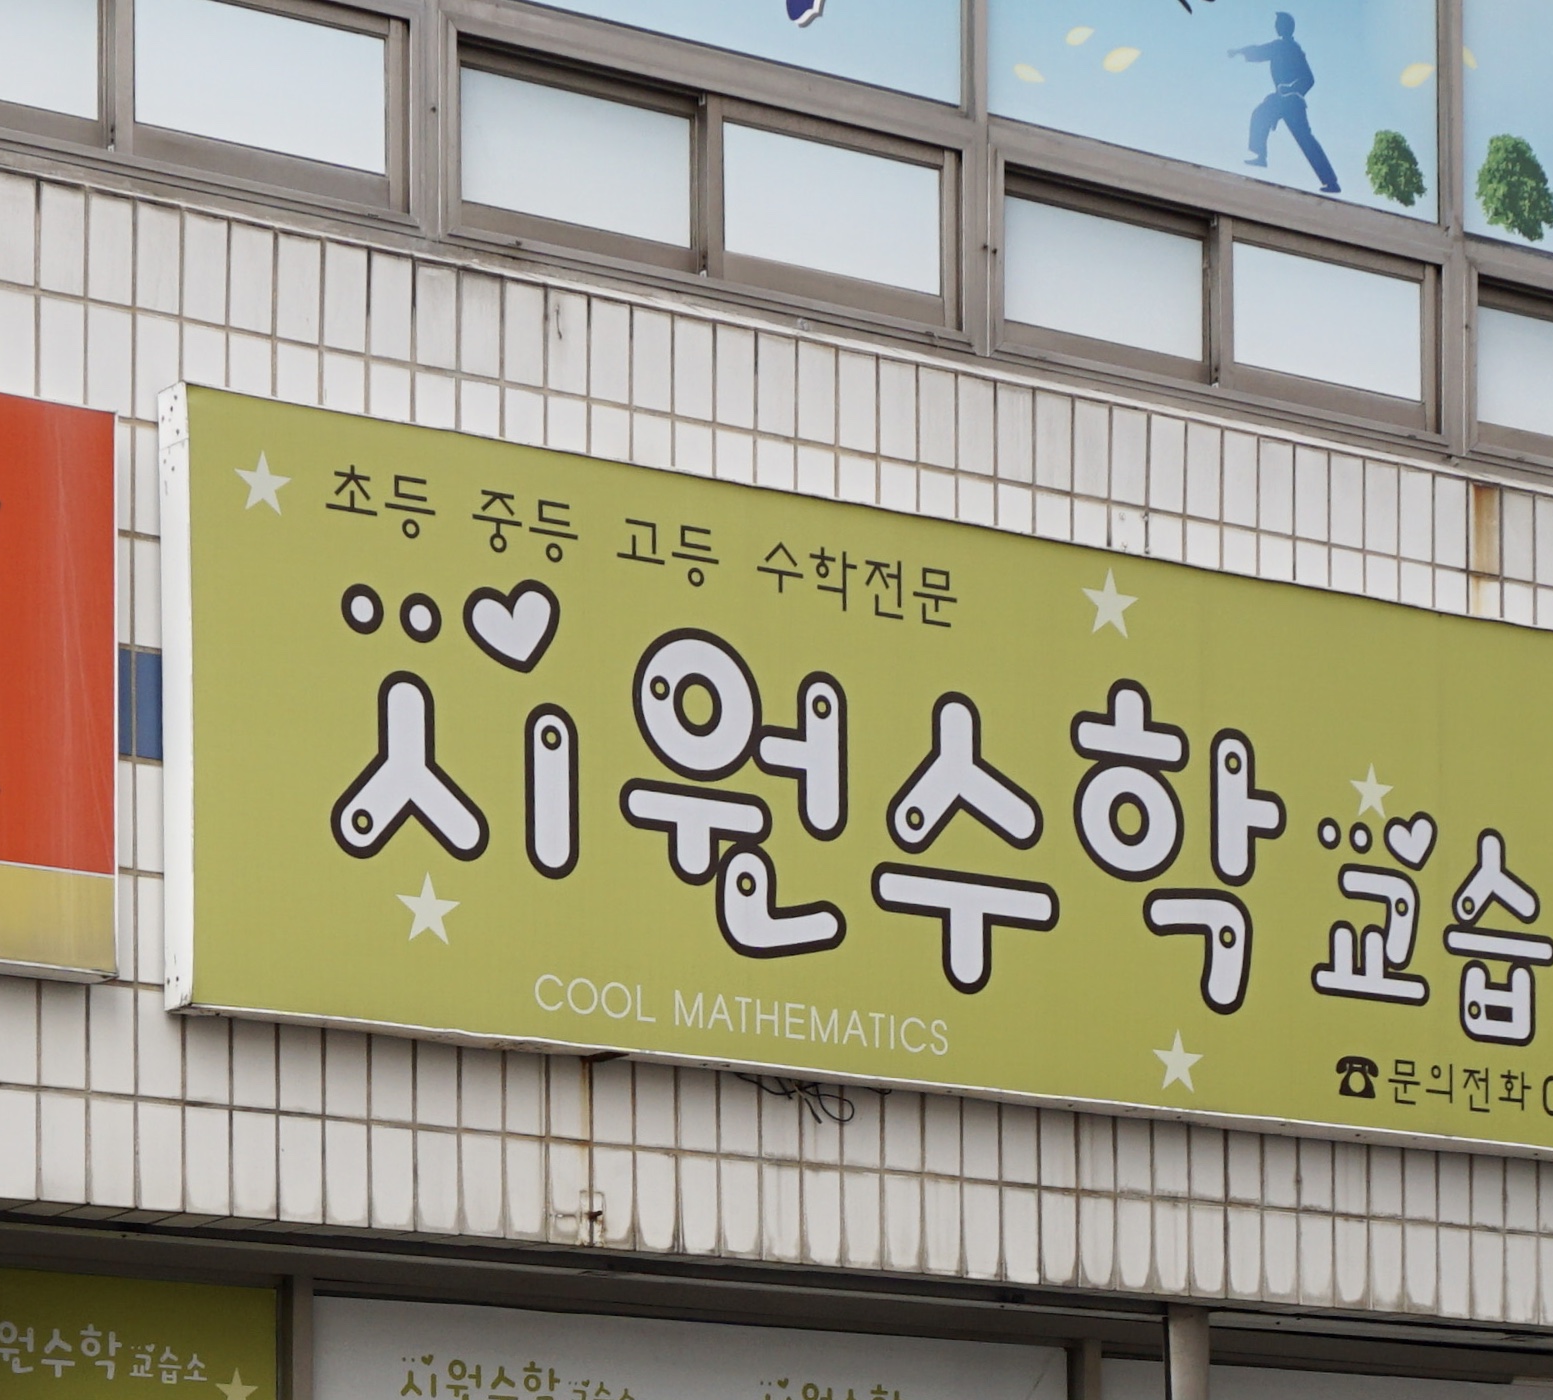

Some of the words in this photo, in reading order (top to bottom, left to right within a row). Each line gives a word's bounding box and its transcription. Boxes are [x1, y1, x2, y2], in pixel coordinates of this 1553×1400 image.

[325, 465, 437, 539] 초등
[471, 489, 579, 563] 중등
[617, 518, 719, 587] 고등
[756, 542, 958, 628] 수학전문
[330, 620, 1287, 1016] 시원수학
[534, 974, 656, 1024] COOL
[674, 989, 950, 1056] MATHEMATICS
[1388, 1060, 1533, 1115] 문의전화
[129, 1349, 208, 1386] 교습소
